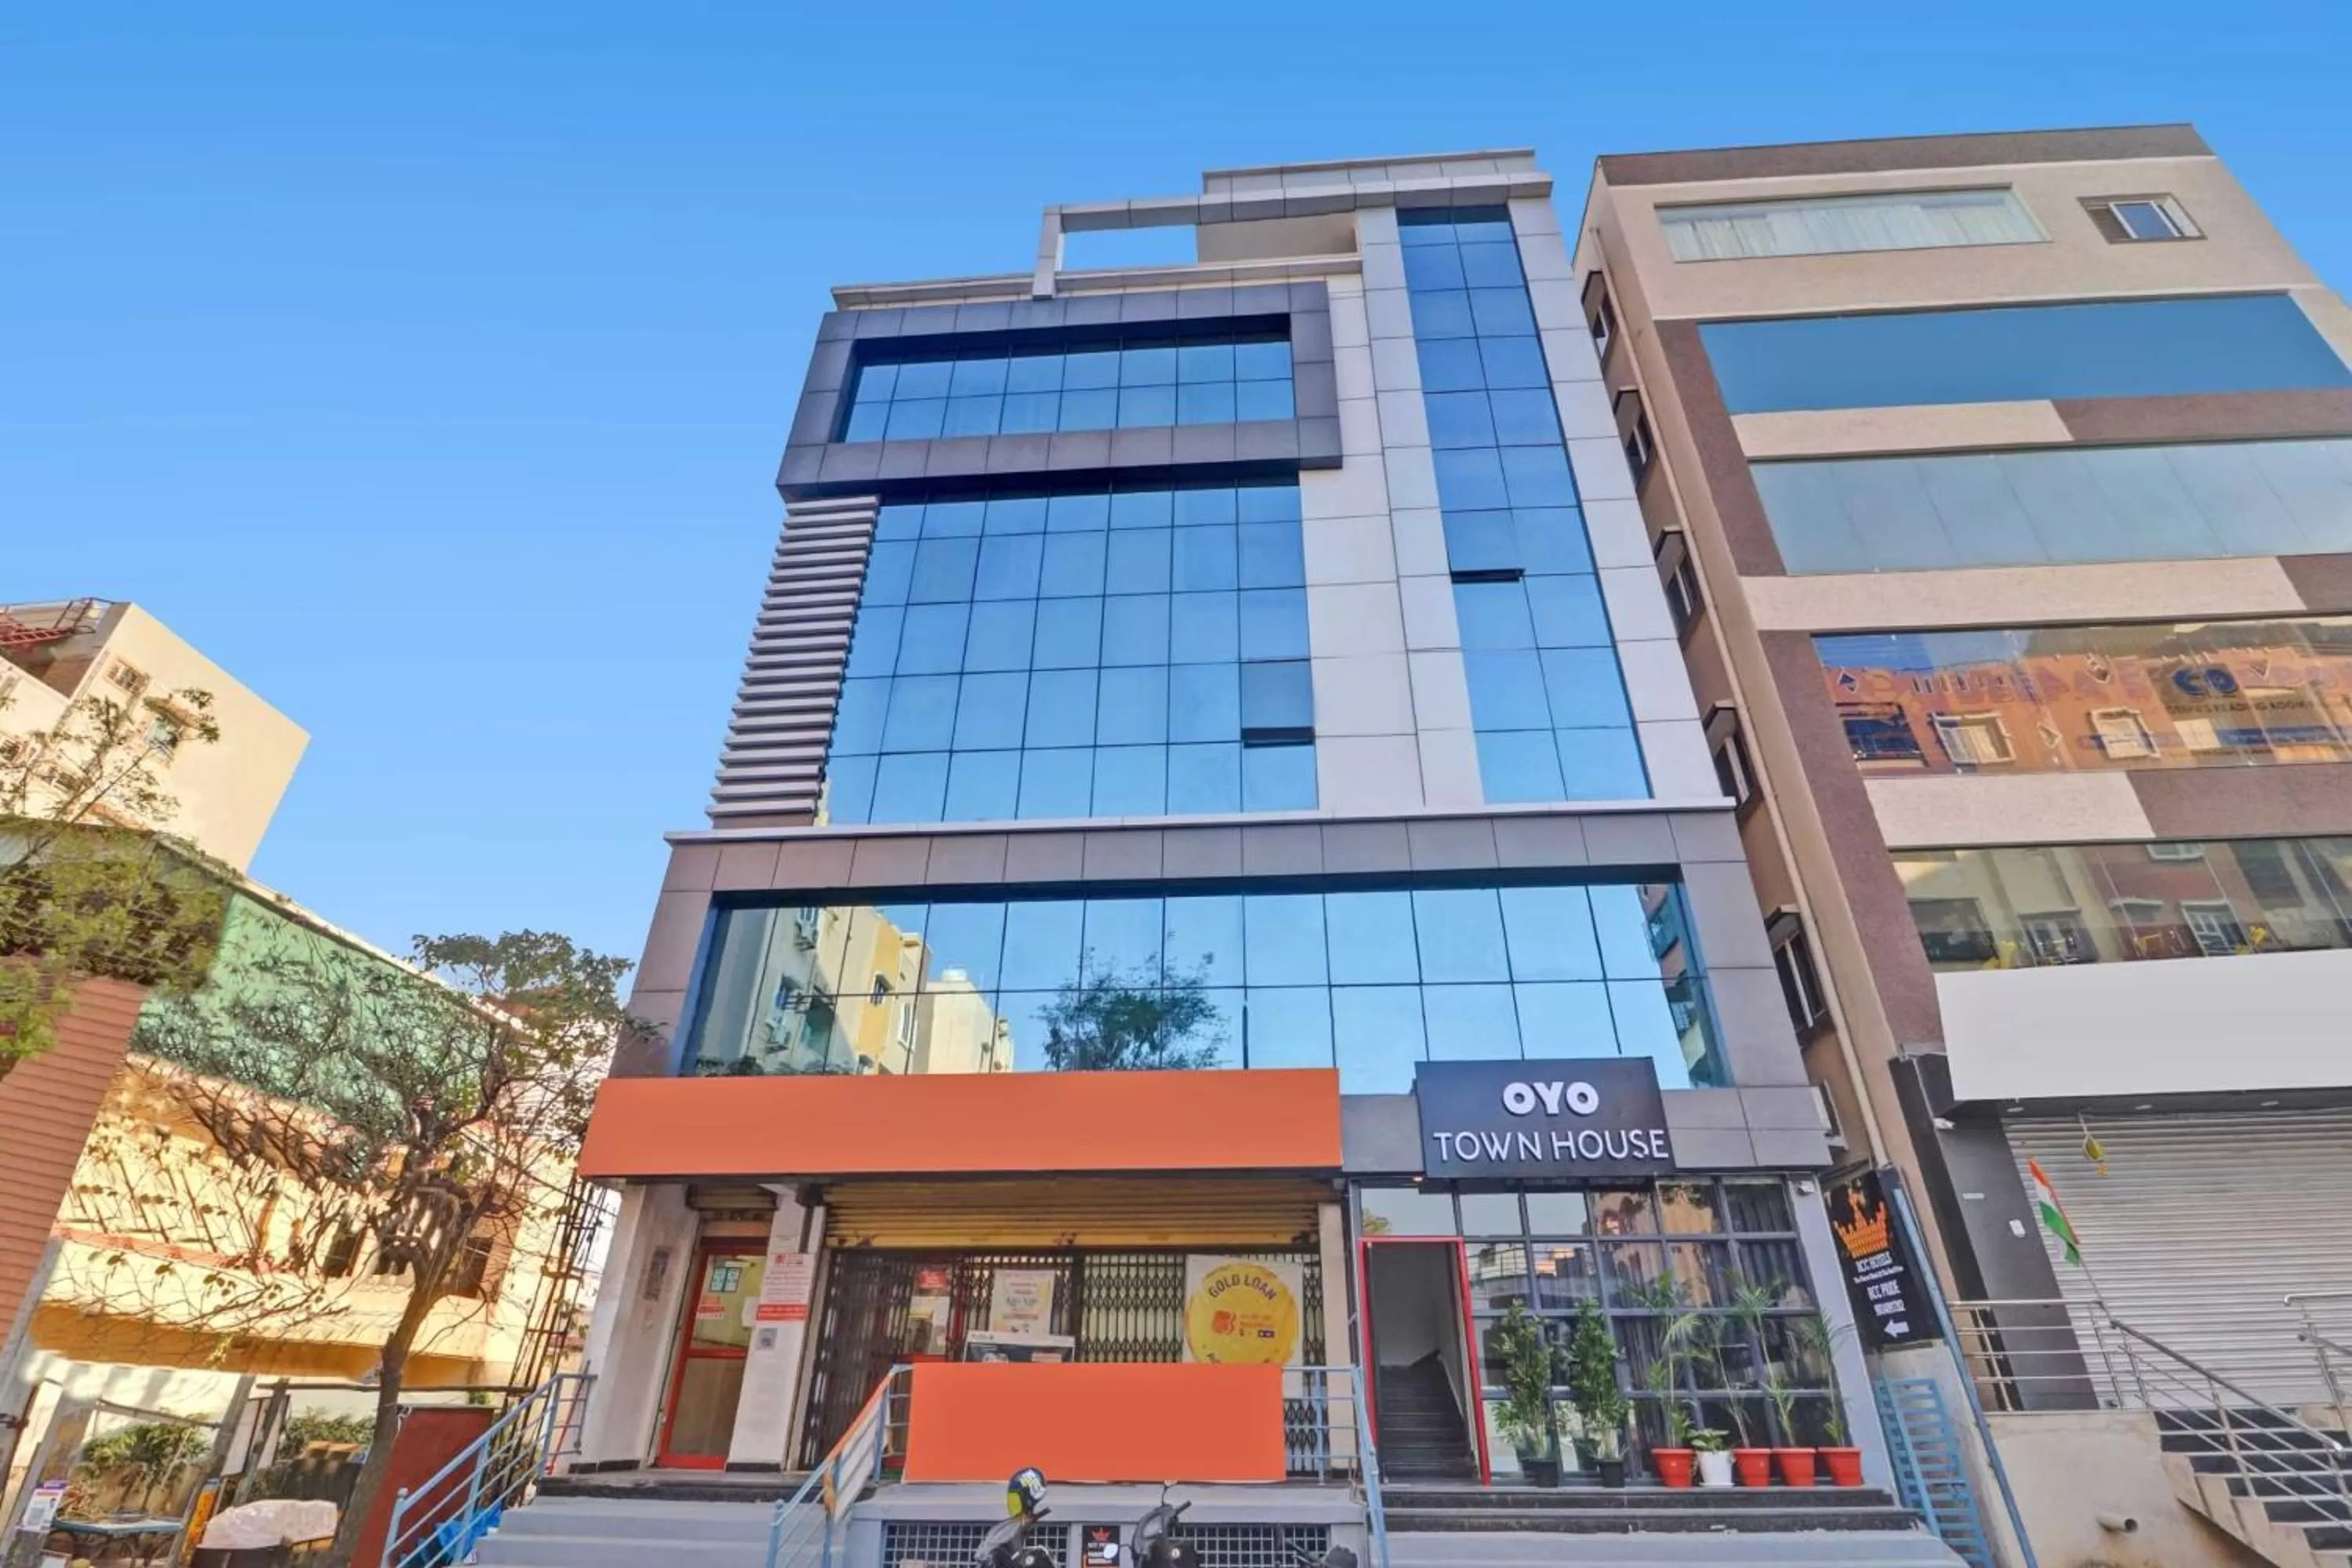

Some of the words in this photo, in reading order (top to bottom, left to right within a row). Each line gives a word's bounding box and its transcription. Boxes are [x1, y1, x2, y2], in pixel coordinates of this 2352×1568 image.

[1502, 1081, 1599, 1115] OYO
[1433, 1131, 1542, 1161] TOWN
[1551, 1129, 1669, 1160] HOUSE
[1208, 1274, 1240, 1298] GOLD
[1244, 1274, 1277, 1301] LOAN
